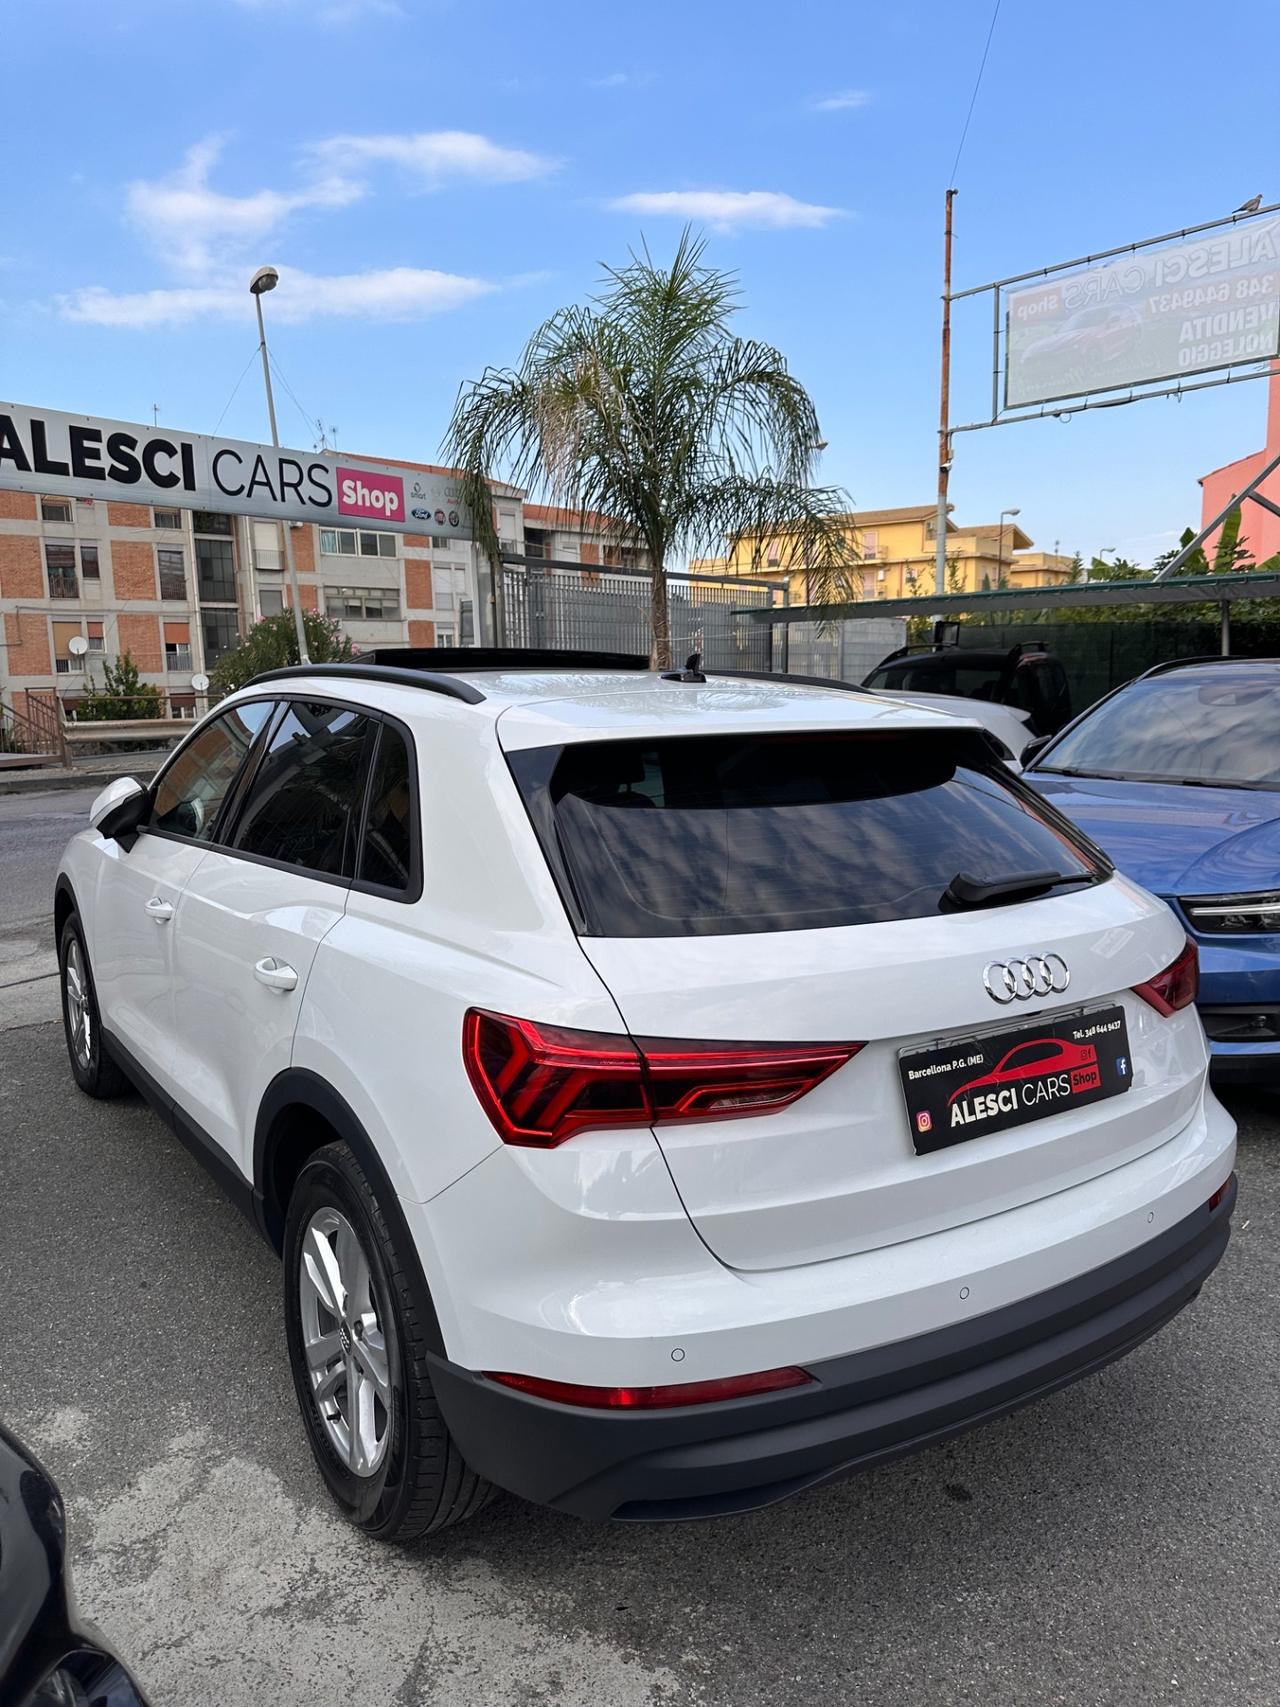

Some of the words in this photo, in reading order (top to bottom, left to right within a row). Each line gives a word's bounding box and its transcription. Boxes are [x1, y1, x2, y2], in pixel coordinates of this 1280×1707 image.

[0, 414, 197, 492] ALESCI
[211, 449, 333, 508] CARS
[342, 479, 399, 516] Shop
[1085, 1026, 1096, 1038] 348
[1096, 1024, 1108, 1034] 644
[1108, 1020, 1121, 1031] 9437
[908, 1062, 952, 1081] Barcellona
[952, 1058, 967, 1071] P.G.
[967, 1053, 984, 1067] (ME)
[950, 1088, 1019, 1128] ALESCI
[1021, 1074, 1071, 1107] CARS
[1073, 1071, 1097, 1087] Shop
